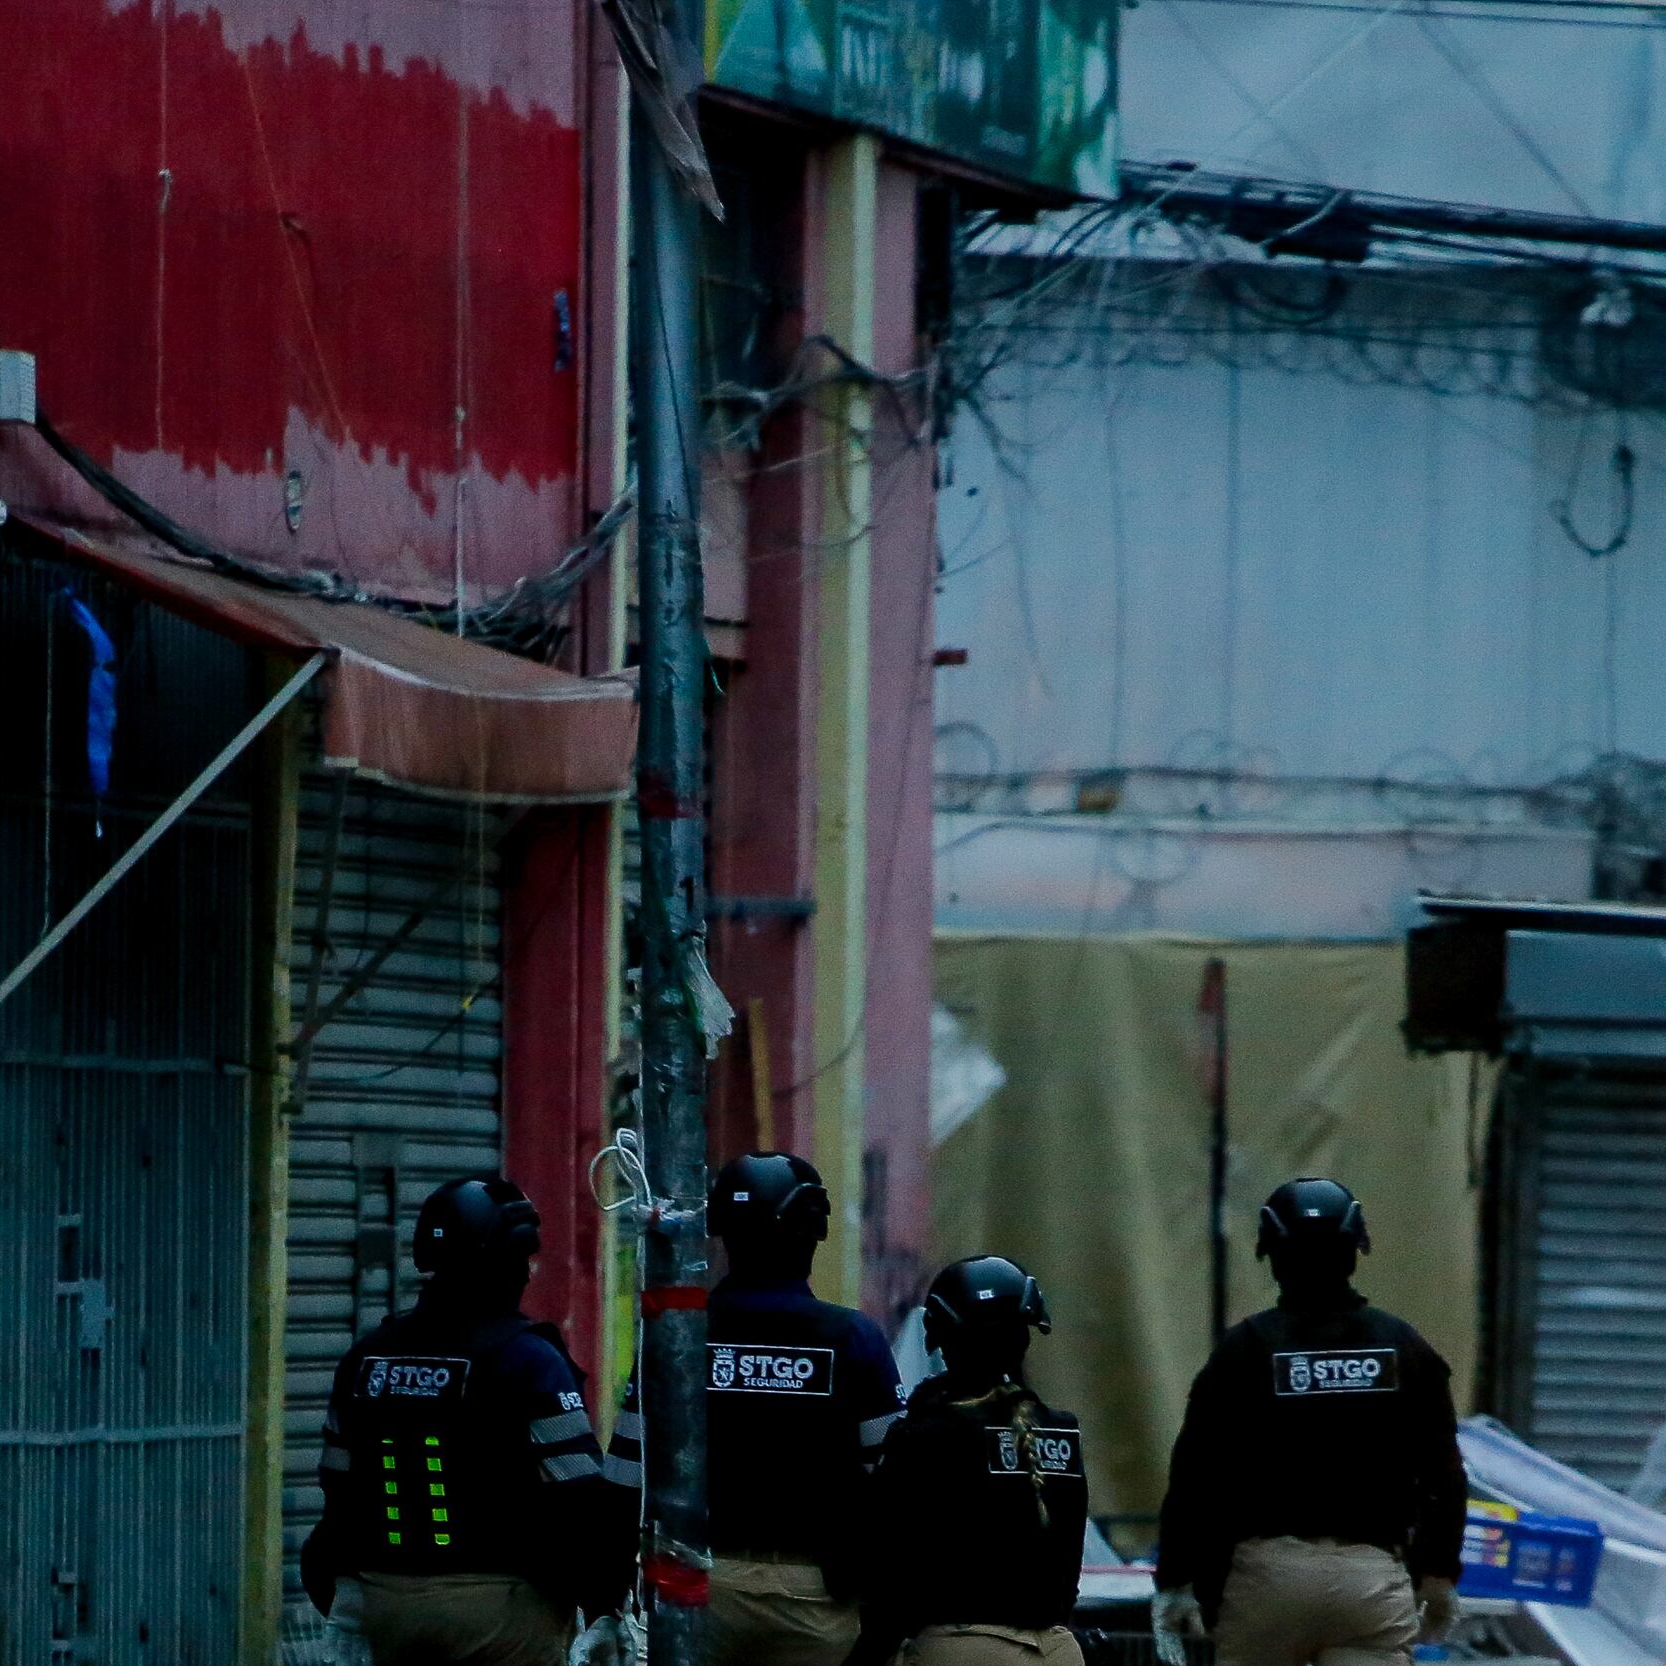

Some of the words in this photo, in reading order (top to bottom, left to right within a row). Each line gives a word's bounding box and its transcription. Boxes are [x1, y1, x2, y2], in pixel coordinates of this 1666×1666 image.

[389, 1366, 450, 1387] STGO
[736, 1355, 814, 1379] STGO
[1312, 1358, 1381, 1380] STGO
[743, 1377, 803, 1390] SEGURIDAD
[1034, 1437, 1072, 1461] TGO
